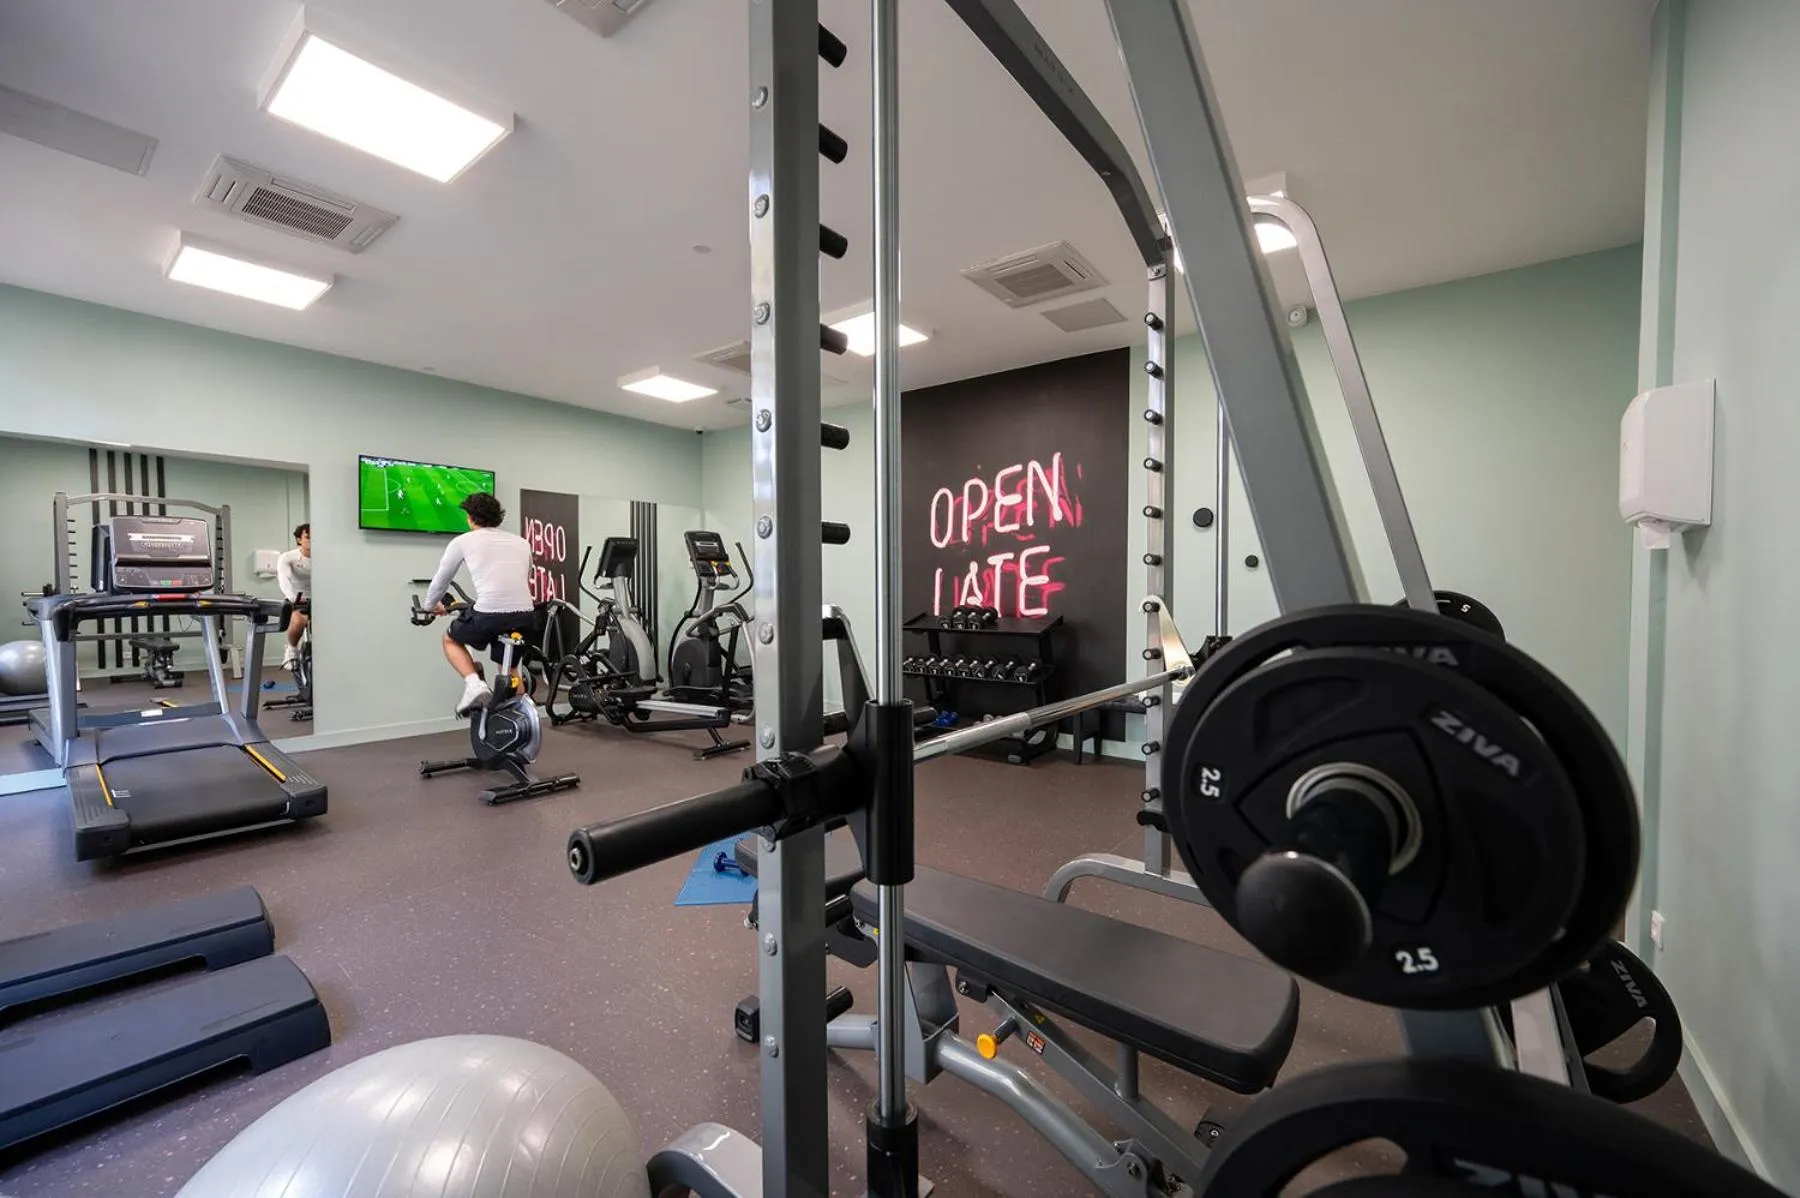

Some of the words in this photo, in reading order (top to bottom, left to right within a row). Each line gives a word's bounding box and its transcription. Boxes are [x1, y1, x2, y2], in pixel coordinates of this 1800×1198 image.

[930, 452, 1064, 548] OPEN
[1430, 709, 1521, 777] ZIVA
[1200, 766, 1220, 798] 2.5
[1396, 947, 1439, 975] 2.5
[1610, 959, 1648, 1008] ZIVA
